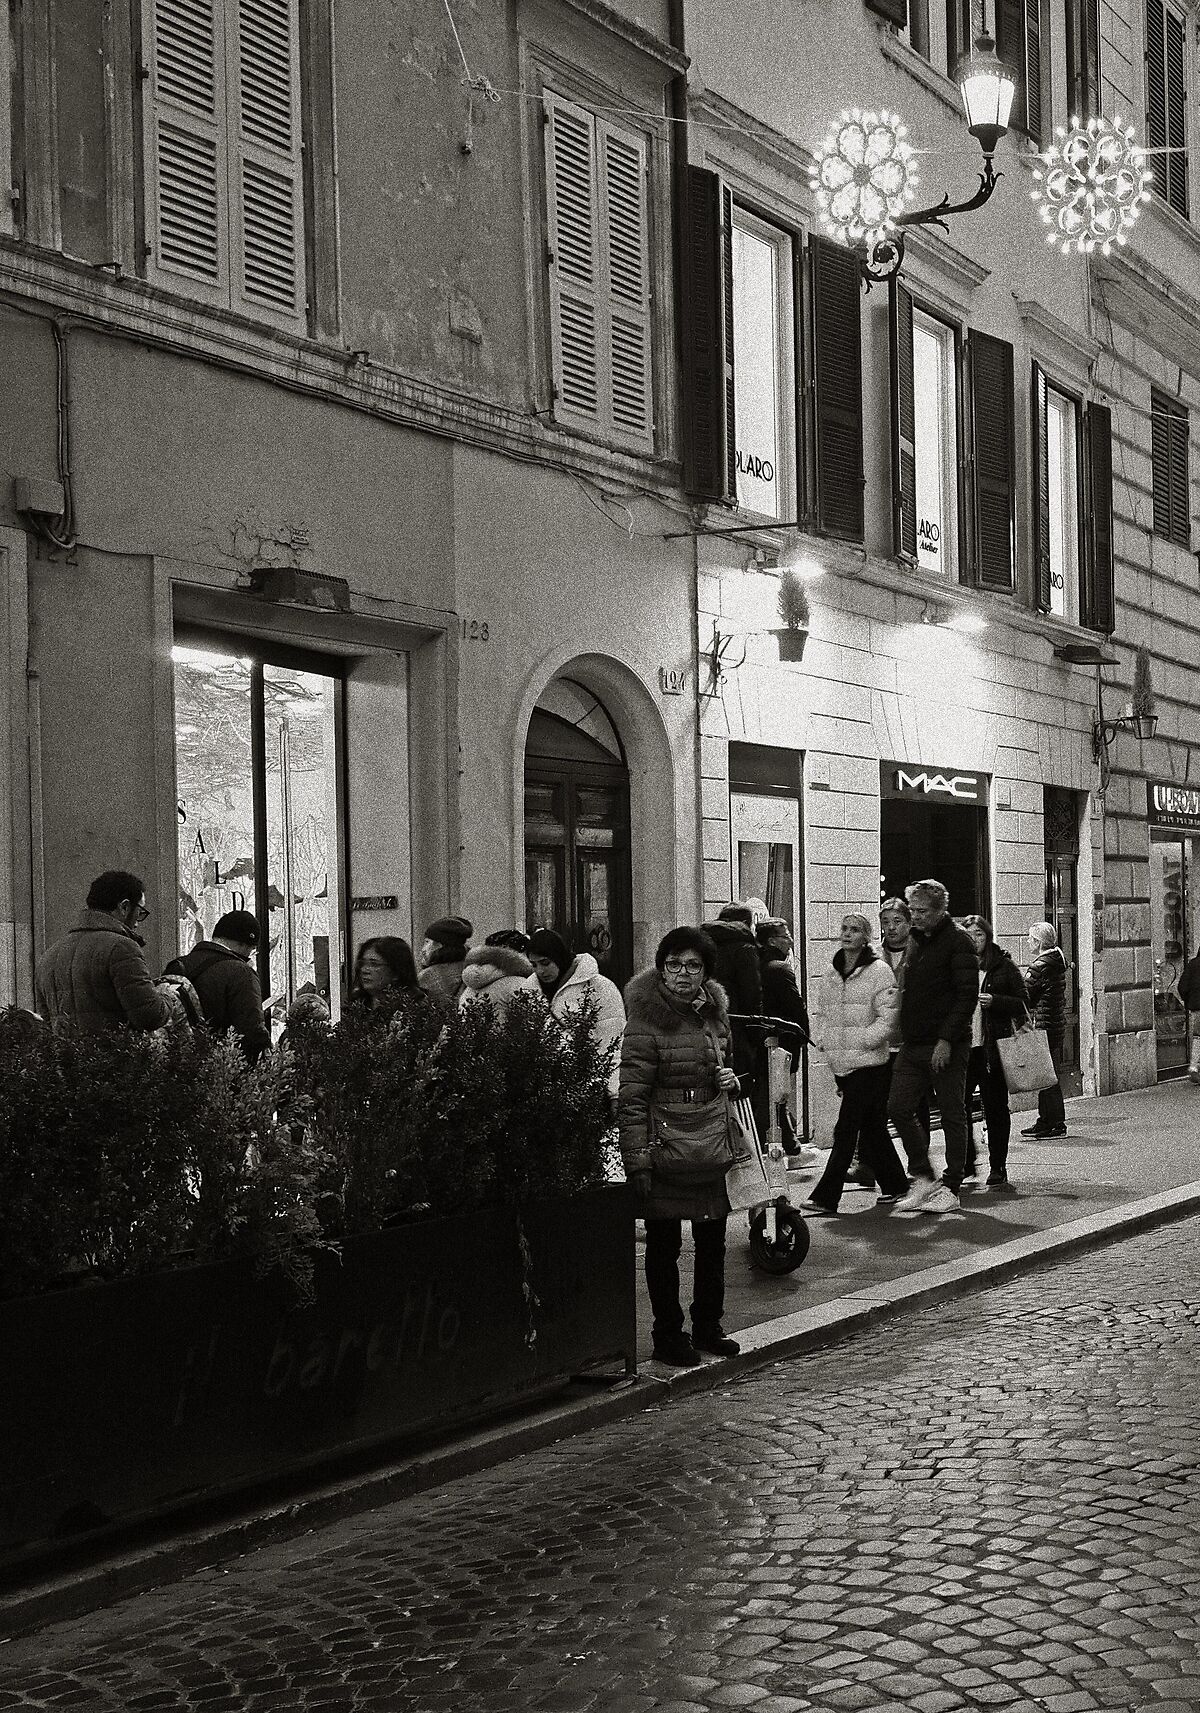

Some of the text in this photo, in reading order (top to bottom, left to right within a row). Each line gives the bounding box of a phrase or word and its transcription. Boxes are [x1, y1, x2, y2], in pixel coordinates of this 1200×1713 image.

[917, 518, 940, 541] ARO
[463, 619, 490, 642] 123
[663, 670, 685, 691] 124
[897, 769, 978, 799] MAC
